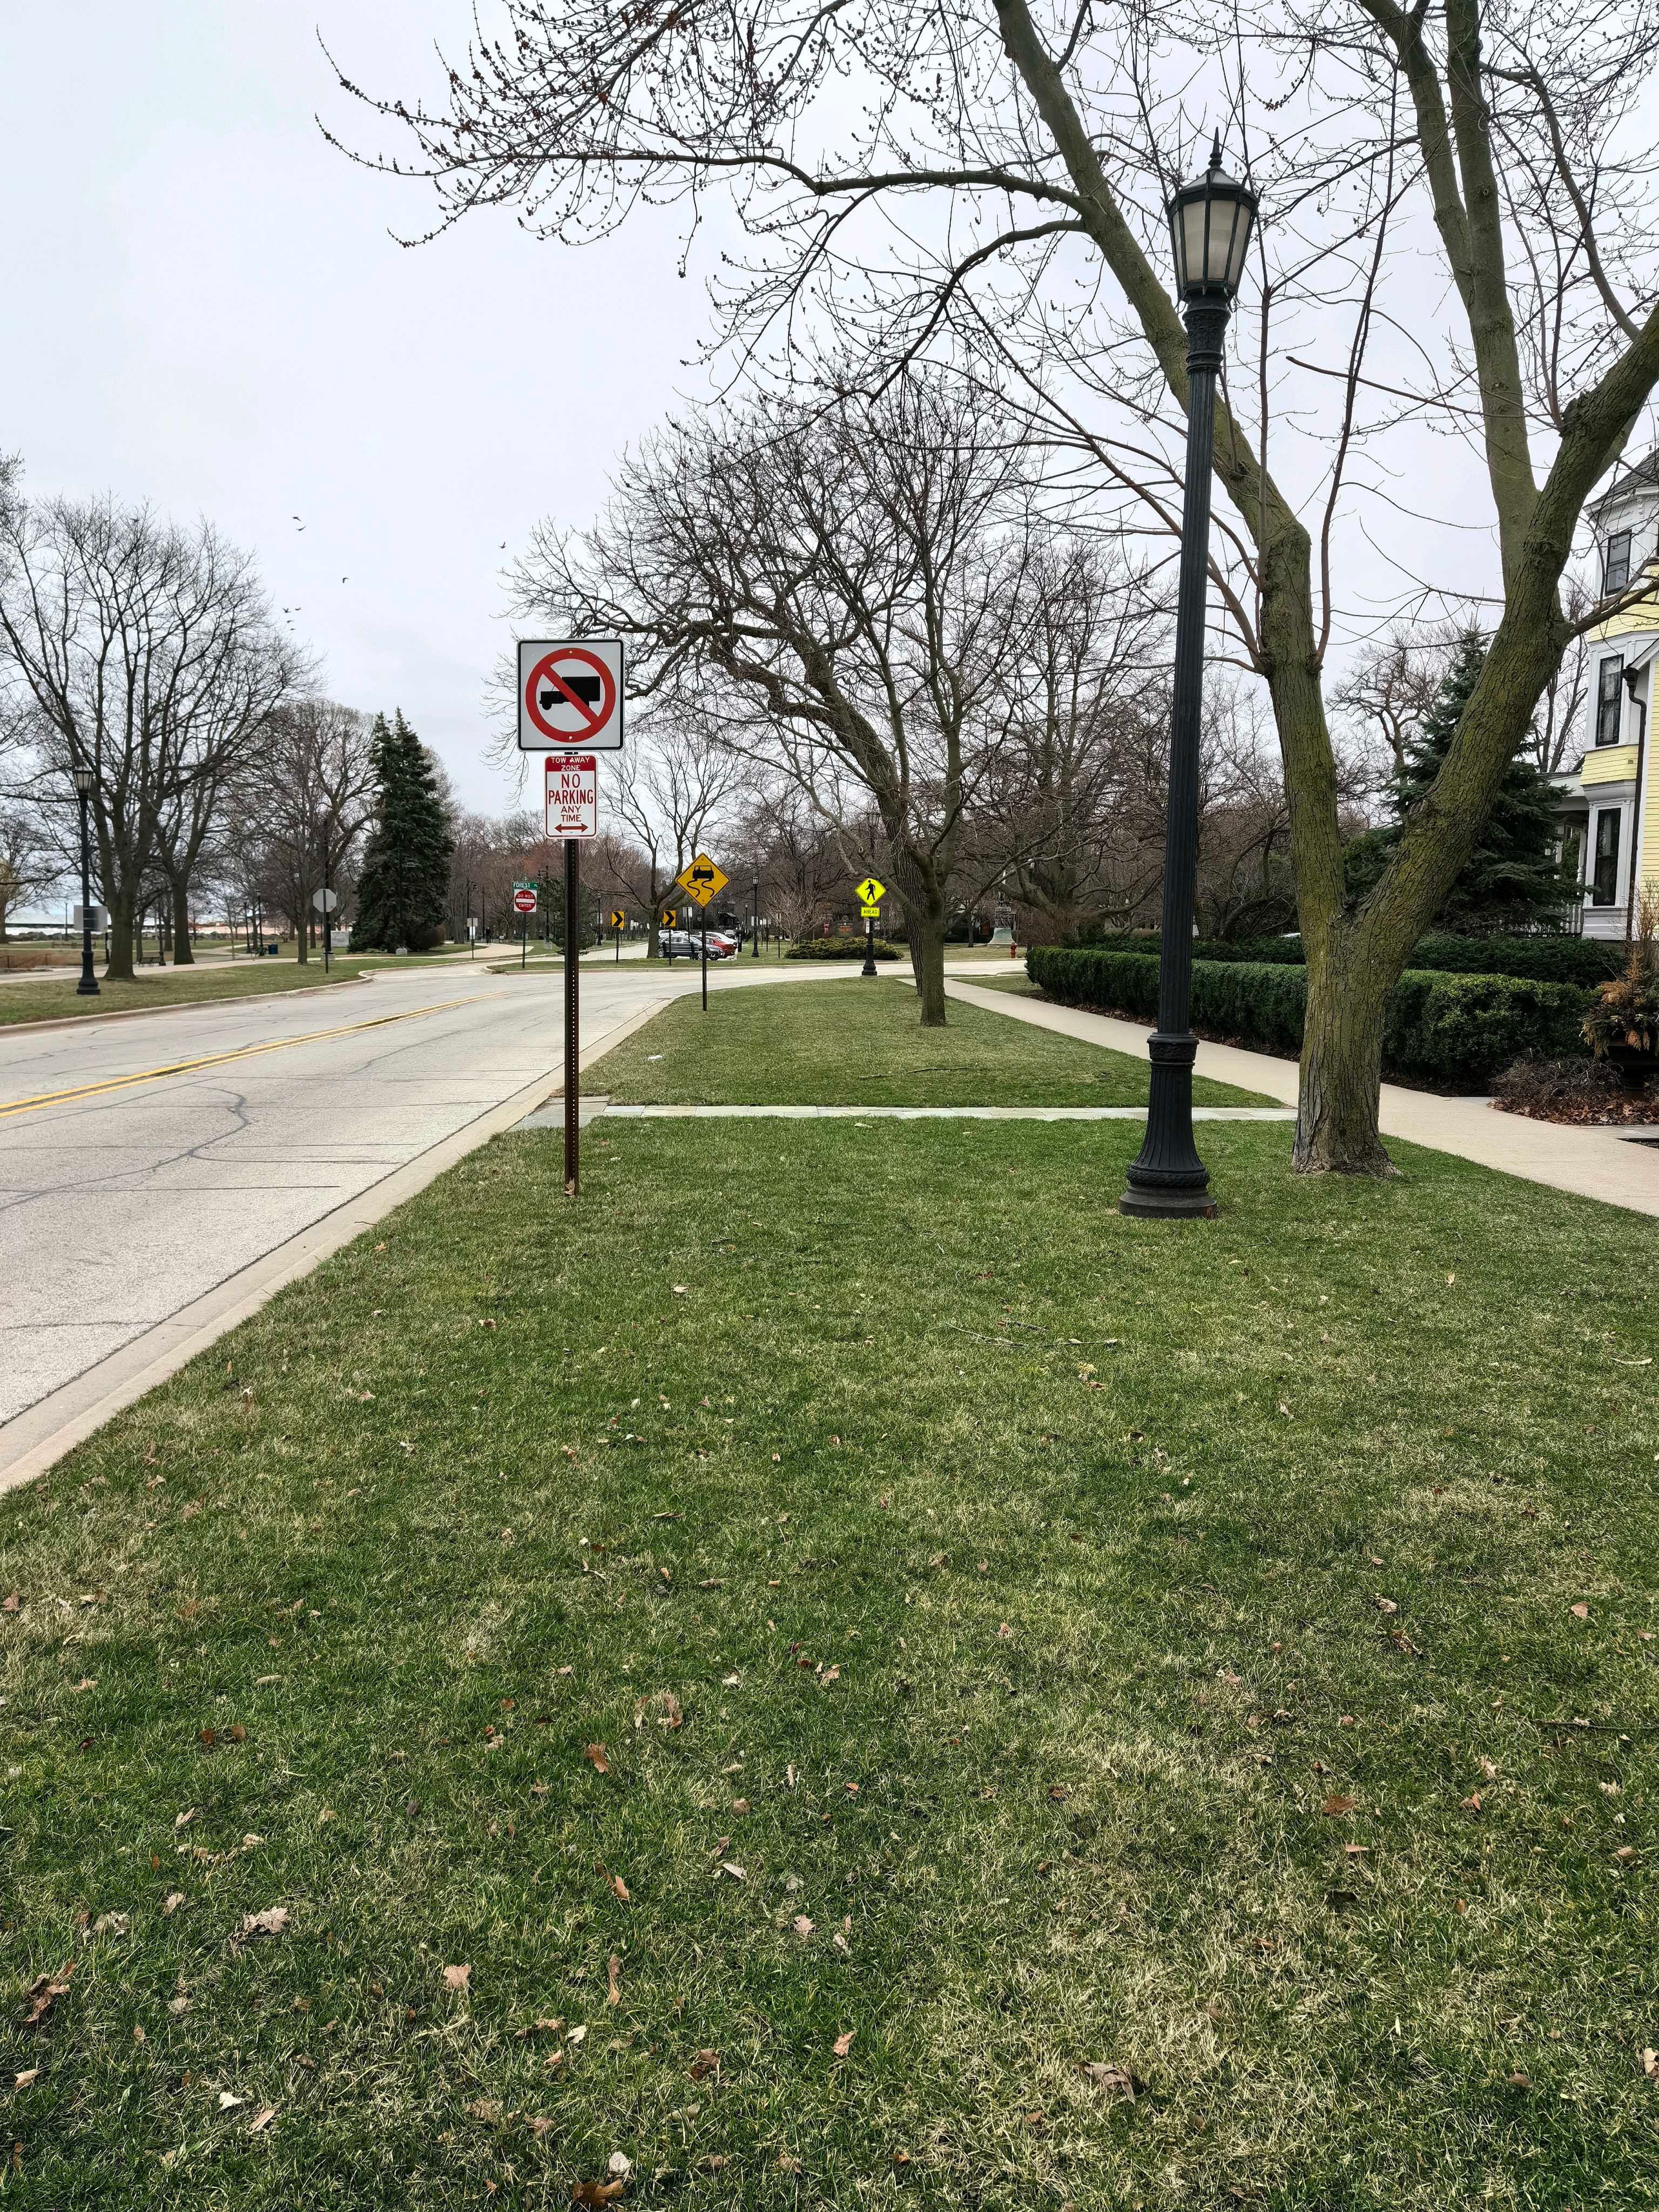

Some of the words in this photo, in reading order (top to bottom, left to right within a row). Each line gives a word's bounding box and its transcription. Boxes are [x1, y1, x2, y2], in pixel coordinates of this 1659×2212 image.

[561, 773, 581, 788] NO
[548, 790, 594, 805] PARKING
[561, 805, 581, 813] ANY
